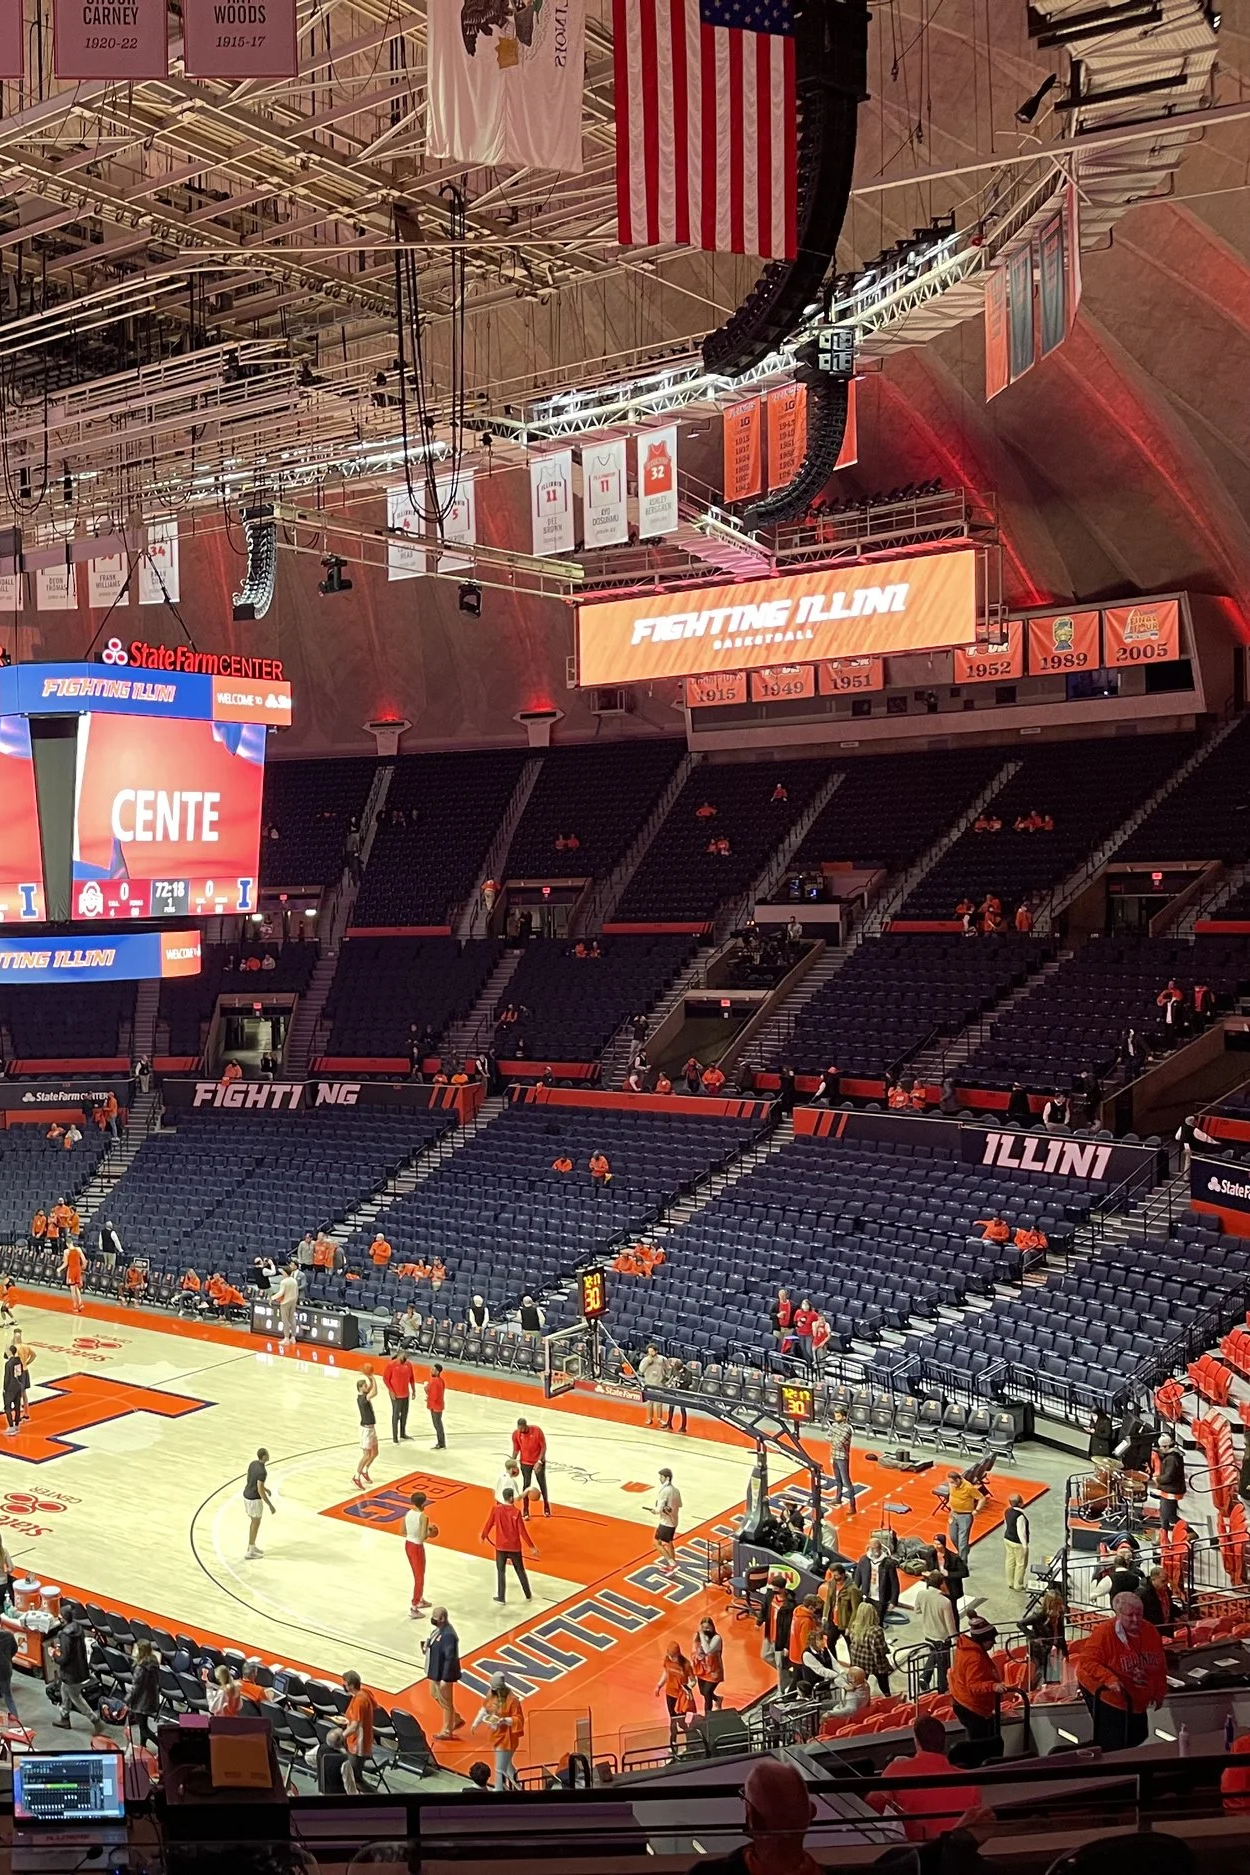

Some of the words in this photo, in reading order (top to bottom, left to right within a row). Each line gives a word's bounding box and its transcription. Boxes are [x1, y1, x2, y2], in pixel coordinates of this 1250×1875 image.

[83, 7, 138, 25] CARNEY
[214, 5, 266, 24] WOODS
[85, 37, 138, 49] 1920-22
[215, 36, 266, 48] 1915-17
[650, 466, 665, 480] 32
[541, 480, 562, 491] ILLINOIS
[599, 481, 610, 493] 11
[546, 490, 558, 503] 11
[452, 509, 459, 521] 5
[592, 515, 620, 525] DOSUNMU
[600, 508, 611, 518] AYO
[402, 518, 410, 530] 4
[542, 524, 563, 534] BROWN
[547, 517, 558, 526] DEE
[150, 546, 166, 557] 34
[95, 580, 121, 590] WILLIAMS
[99, 574, 117, 583] FRANK
[631, 599, 792, 646] FIGHTING
[796, 583, 910, 625] ILLINI
[1130, 613, 1159, 626] FINAL
[1133, 621, 1159, 632] FOUR
[713, 629, 814, 651] BASKETBALL
[1116, 642, 1168, 662] 2005
[219, 656, 284, 680] CENTER
[1040, 653, 1088, 670] 1989
[966, 661, 1012, 678] 1952
[41, 677, 130, 698] FIGHTING
[132, 683, 176, 702] ILLINI
[762, 681, 803, 697] 1949
[831, 675, 873, 690] 1951
[216, 692, 254, 707] WELCOME
[697, 687, 736, 702] 1915
[111, 789, 221, 842] CENTE
[119, 882, 129, 900] 0
[155, 881, 185, 898] 72:18
[205, 880, 214, 897] 0
[167, 897, 173, 907] 1
[53, 949, 116, 968] ILLINI
[193, 1083, 305, 1109] FIGHTI
[316, 1083, 361, 1107] NG
[982, 1133, 1113, 1180] ILLINI
[585, 1288, 601, 1312] 30
[265, 1319, 273, 1329] 0
[311, 1327, 318, 1338] 0
[328, 1330, 335, 1341] 0
[788, 1400, 805, 1415] 30
[29, 1486, 83, 1504] CENTER
